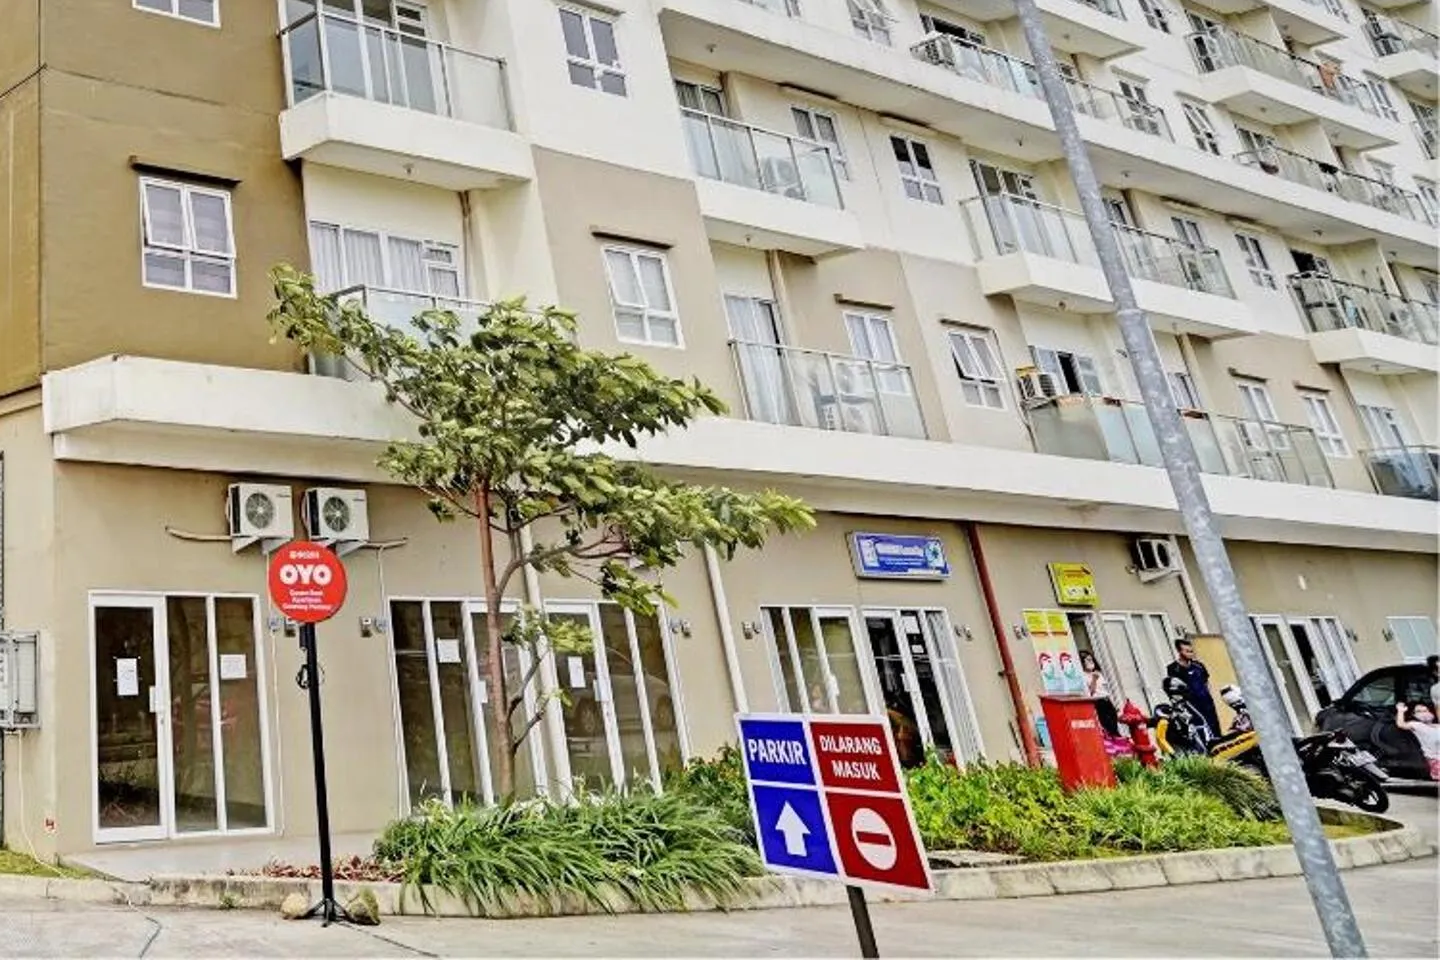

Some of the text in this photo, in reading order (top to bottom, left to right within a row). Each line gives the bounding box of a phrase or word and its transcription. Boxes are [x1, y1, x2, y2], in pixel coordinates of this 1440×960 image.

[279, 563, 332, 586] OYO
[748, 738, 807, 765] PARKIR
[819, 734, 882, 756] DILARANG
[831, 759, 882, 780] MASUK
